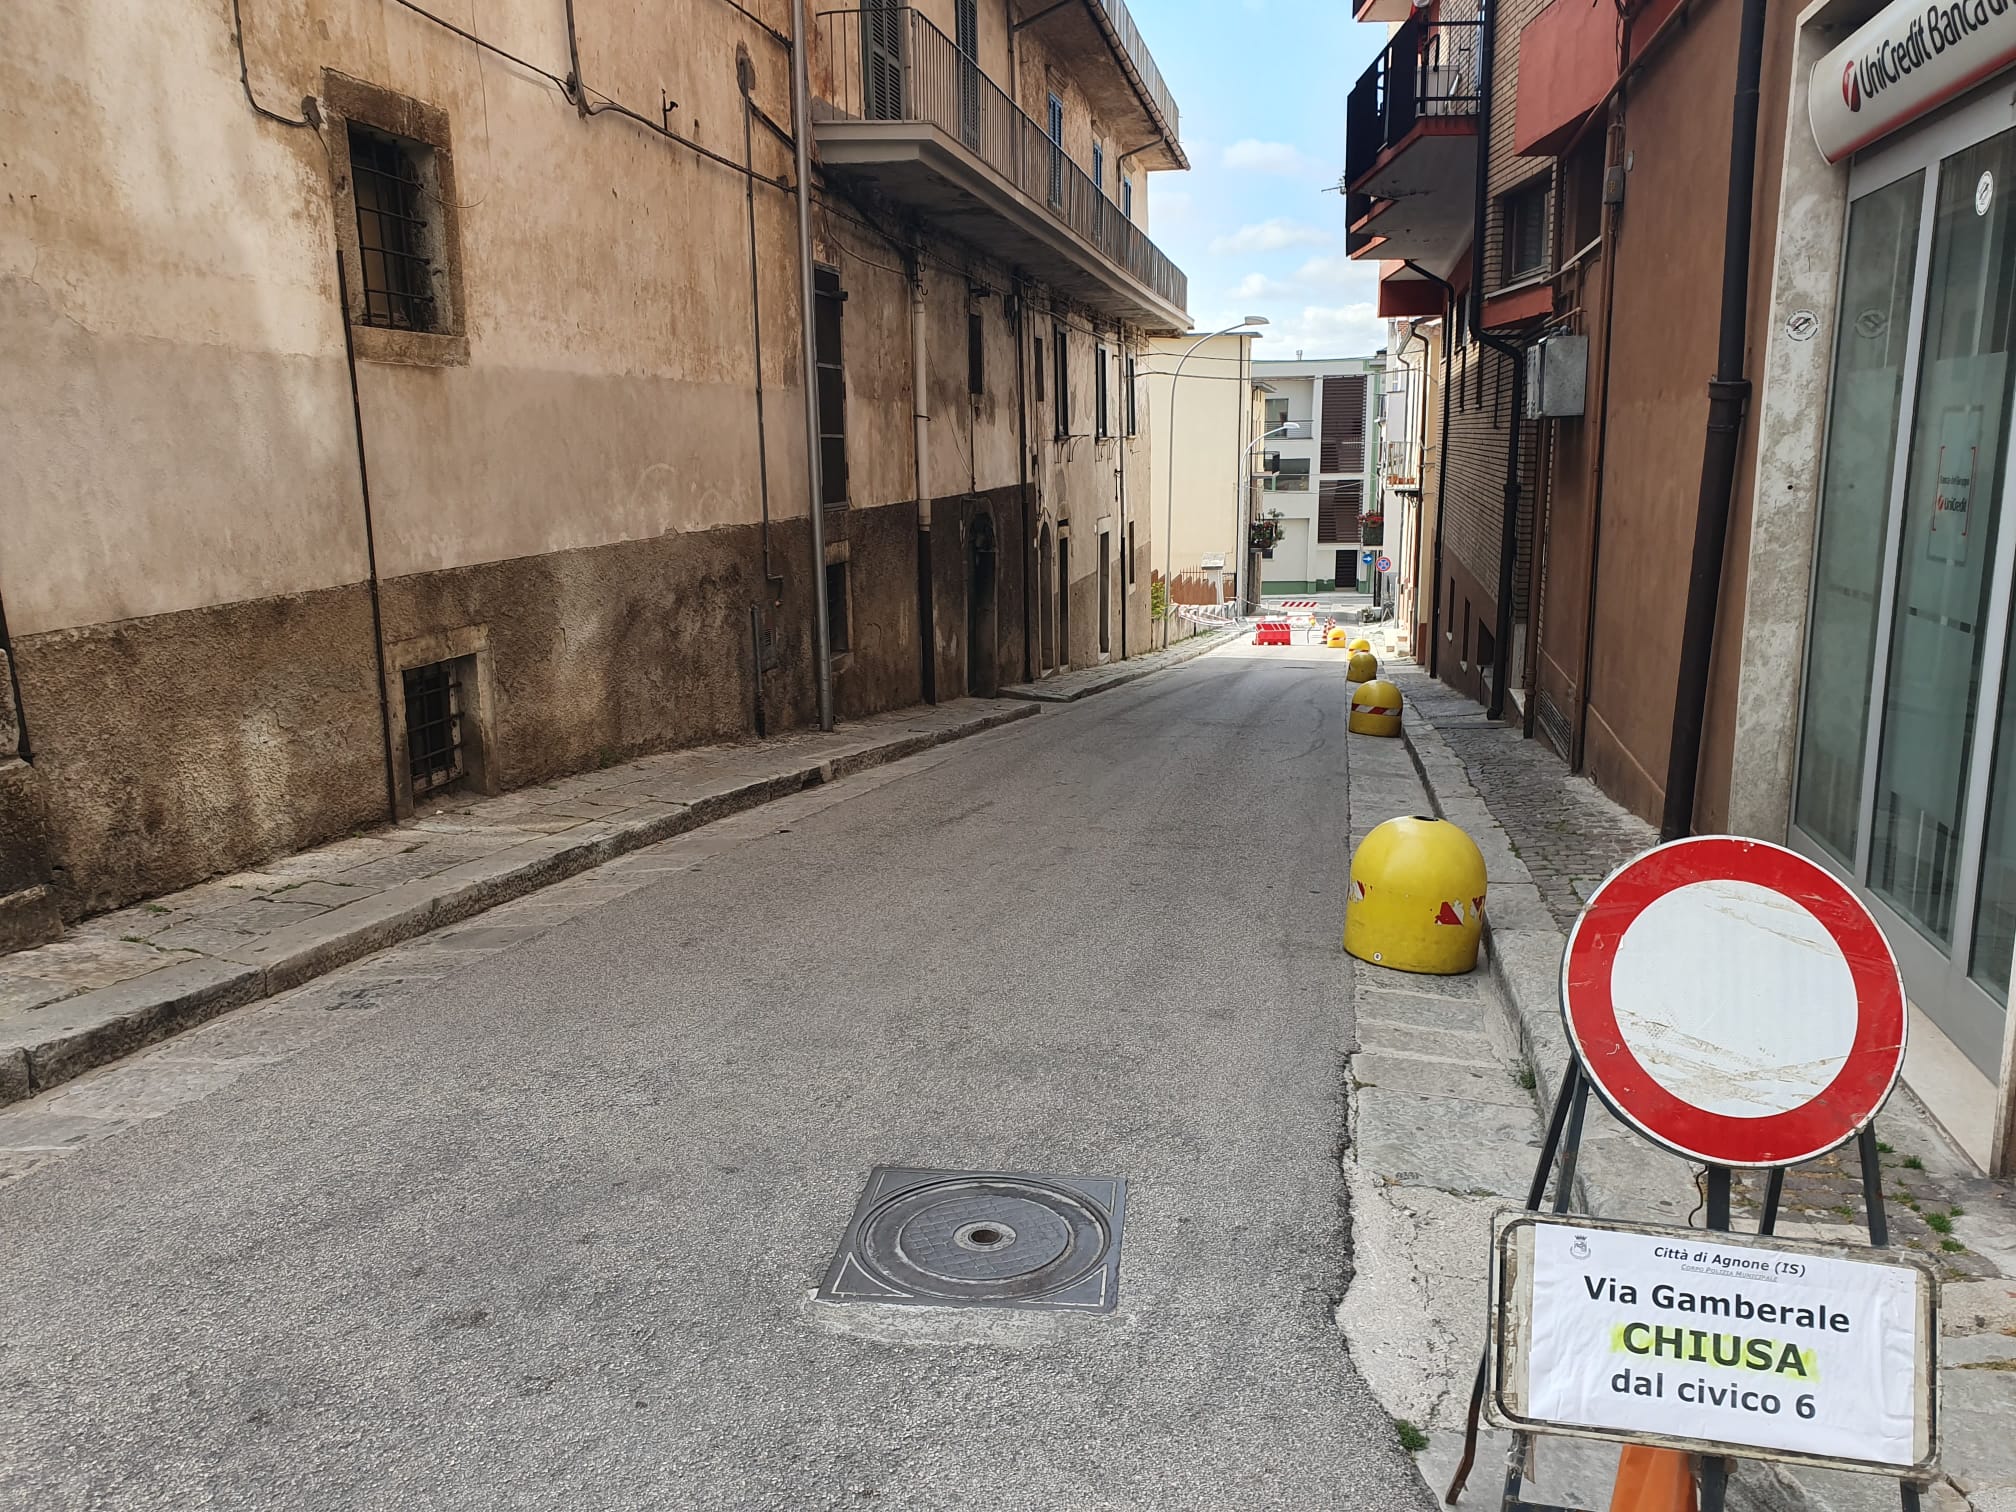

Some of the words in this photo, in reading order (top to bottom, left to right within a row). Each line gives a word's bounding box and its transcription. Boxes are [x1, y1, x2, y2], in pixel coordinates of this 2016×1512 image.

[1860, 14, 1932, 98] UniCredit
[1927, 0, 1990, 55] Banca
[1654, 1247, 1688, 1261] Città
[1693, 1252, 1707, 1263] di
[1712, 1254, 1770, 1271] Agnone
[1774, 1261, 1806, 1278] (IS)
[1584, 1275, 1637, 1304] Via
[1651, 1284, 1850, 1333] Gamberale
[1623, 1322, 1807, 1376] CHIUSA
[1611, 1368, 1663, 1398] dal
[1677, 1378, 1781, 1415] civico
[1795, 1394, 1816, 1419] 6
